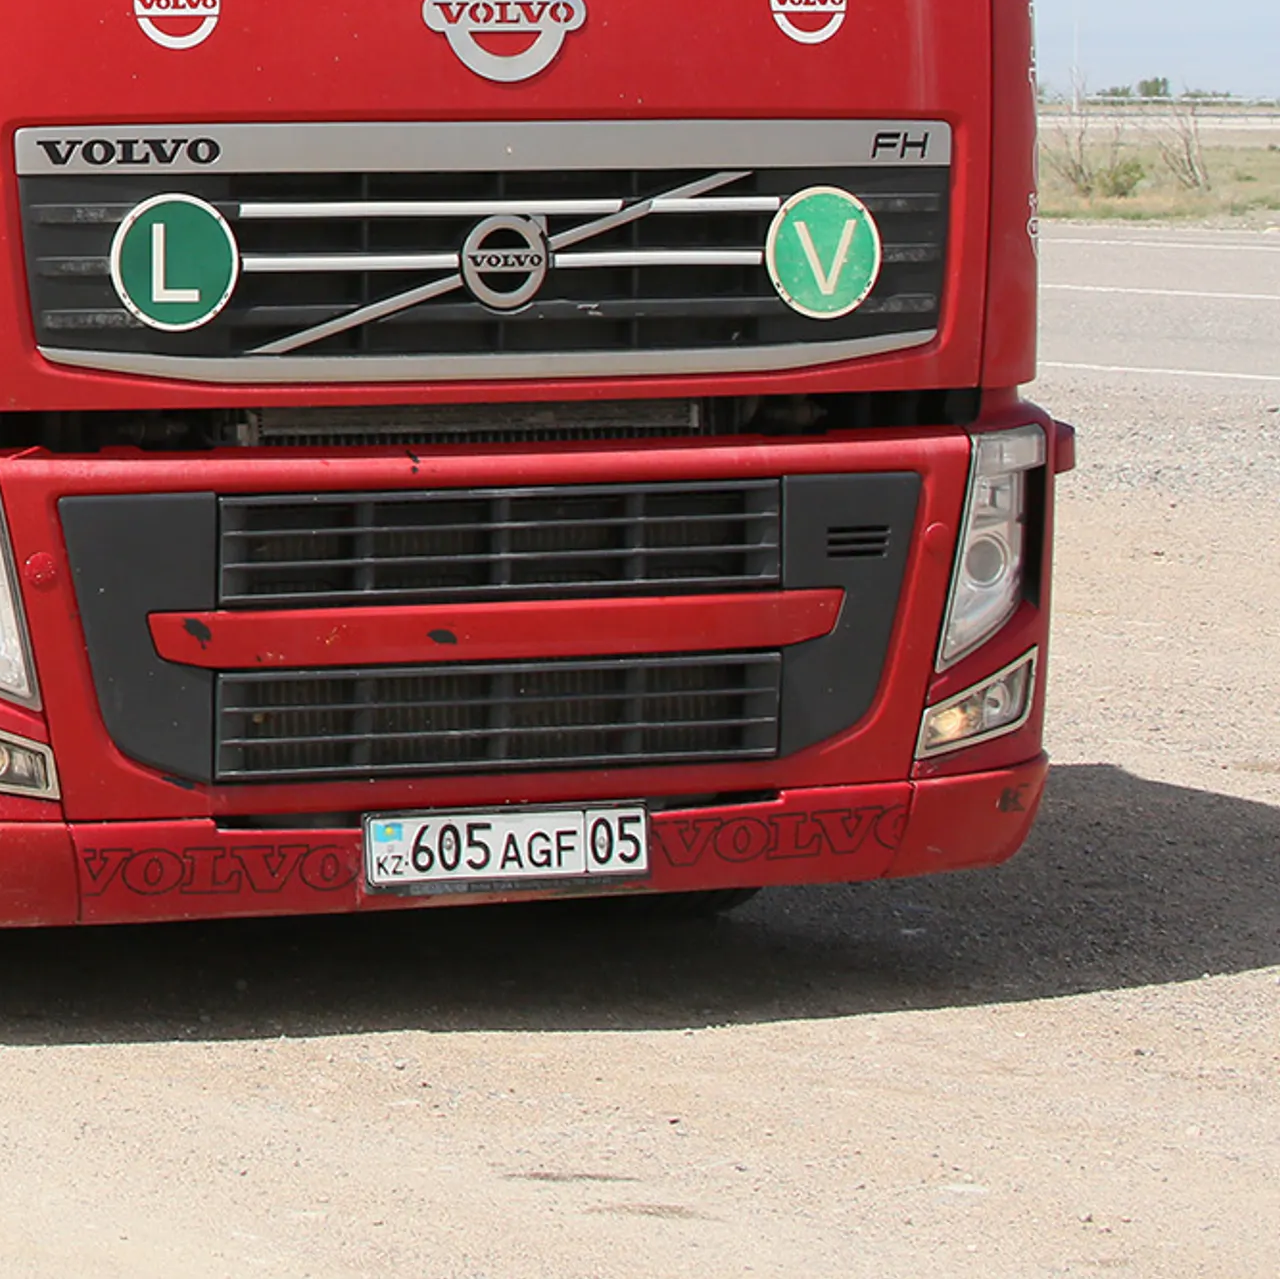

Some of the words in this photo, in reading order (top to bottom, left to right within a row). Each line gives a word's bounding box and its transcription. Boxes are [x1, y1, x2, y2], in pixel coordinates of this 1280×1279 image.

[432, 0, 577, 24] VOLVO
[36, 138, 221, 165] VOLVO
[871, 131, 929, 159] FH
[152, 222, 200, 303] L
[467, 252, 542, 268] VOLVO
[792, 218, 857, 296] V
[376, 854, 404, 876] KZ
[411, 821, 493, 871] 605
[500, 829, 578, 871] AGF
[589, 815, 642, 866] 05
[82, 844, 358, 897] VOLVO
